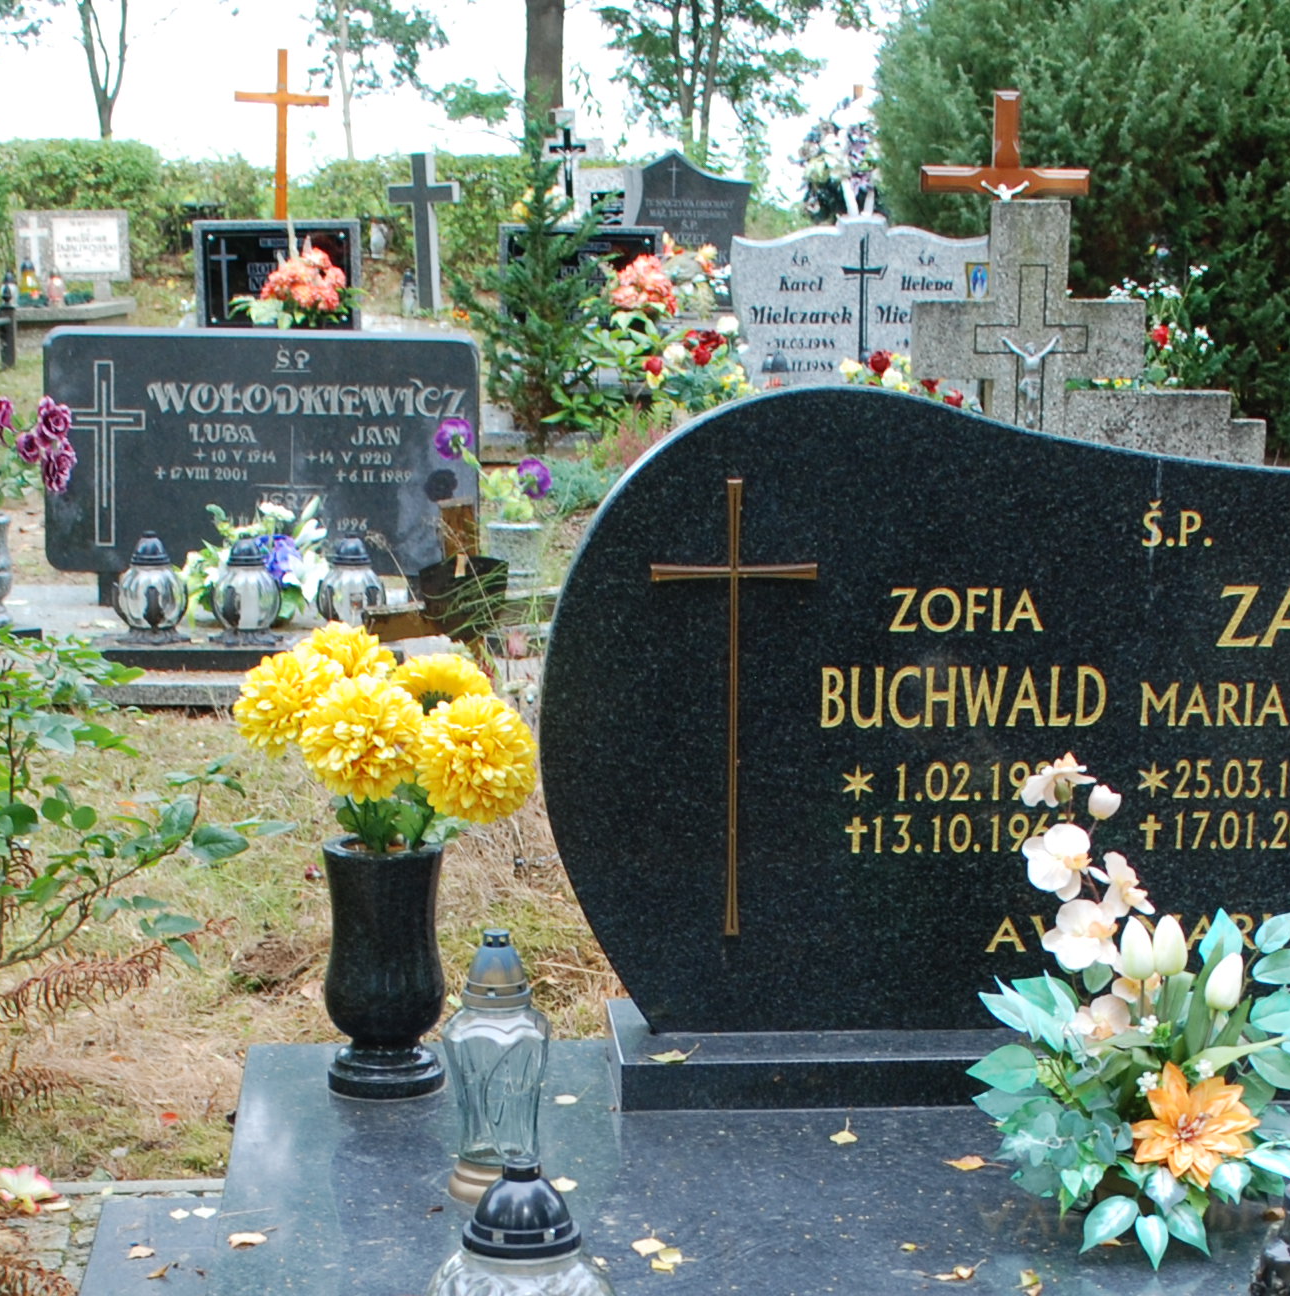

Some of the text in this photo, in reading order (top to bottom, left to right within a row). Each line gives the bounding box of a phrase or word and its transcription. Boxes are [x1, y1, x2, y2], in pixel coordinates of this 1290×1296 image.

[749, 305, 853, 325] Mielczarek
[350, 425, 401, 446] JAN
[888, 586, 1044, 634] ZOFIA
[819, 665, 1107, 730] BUCHWALD
